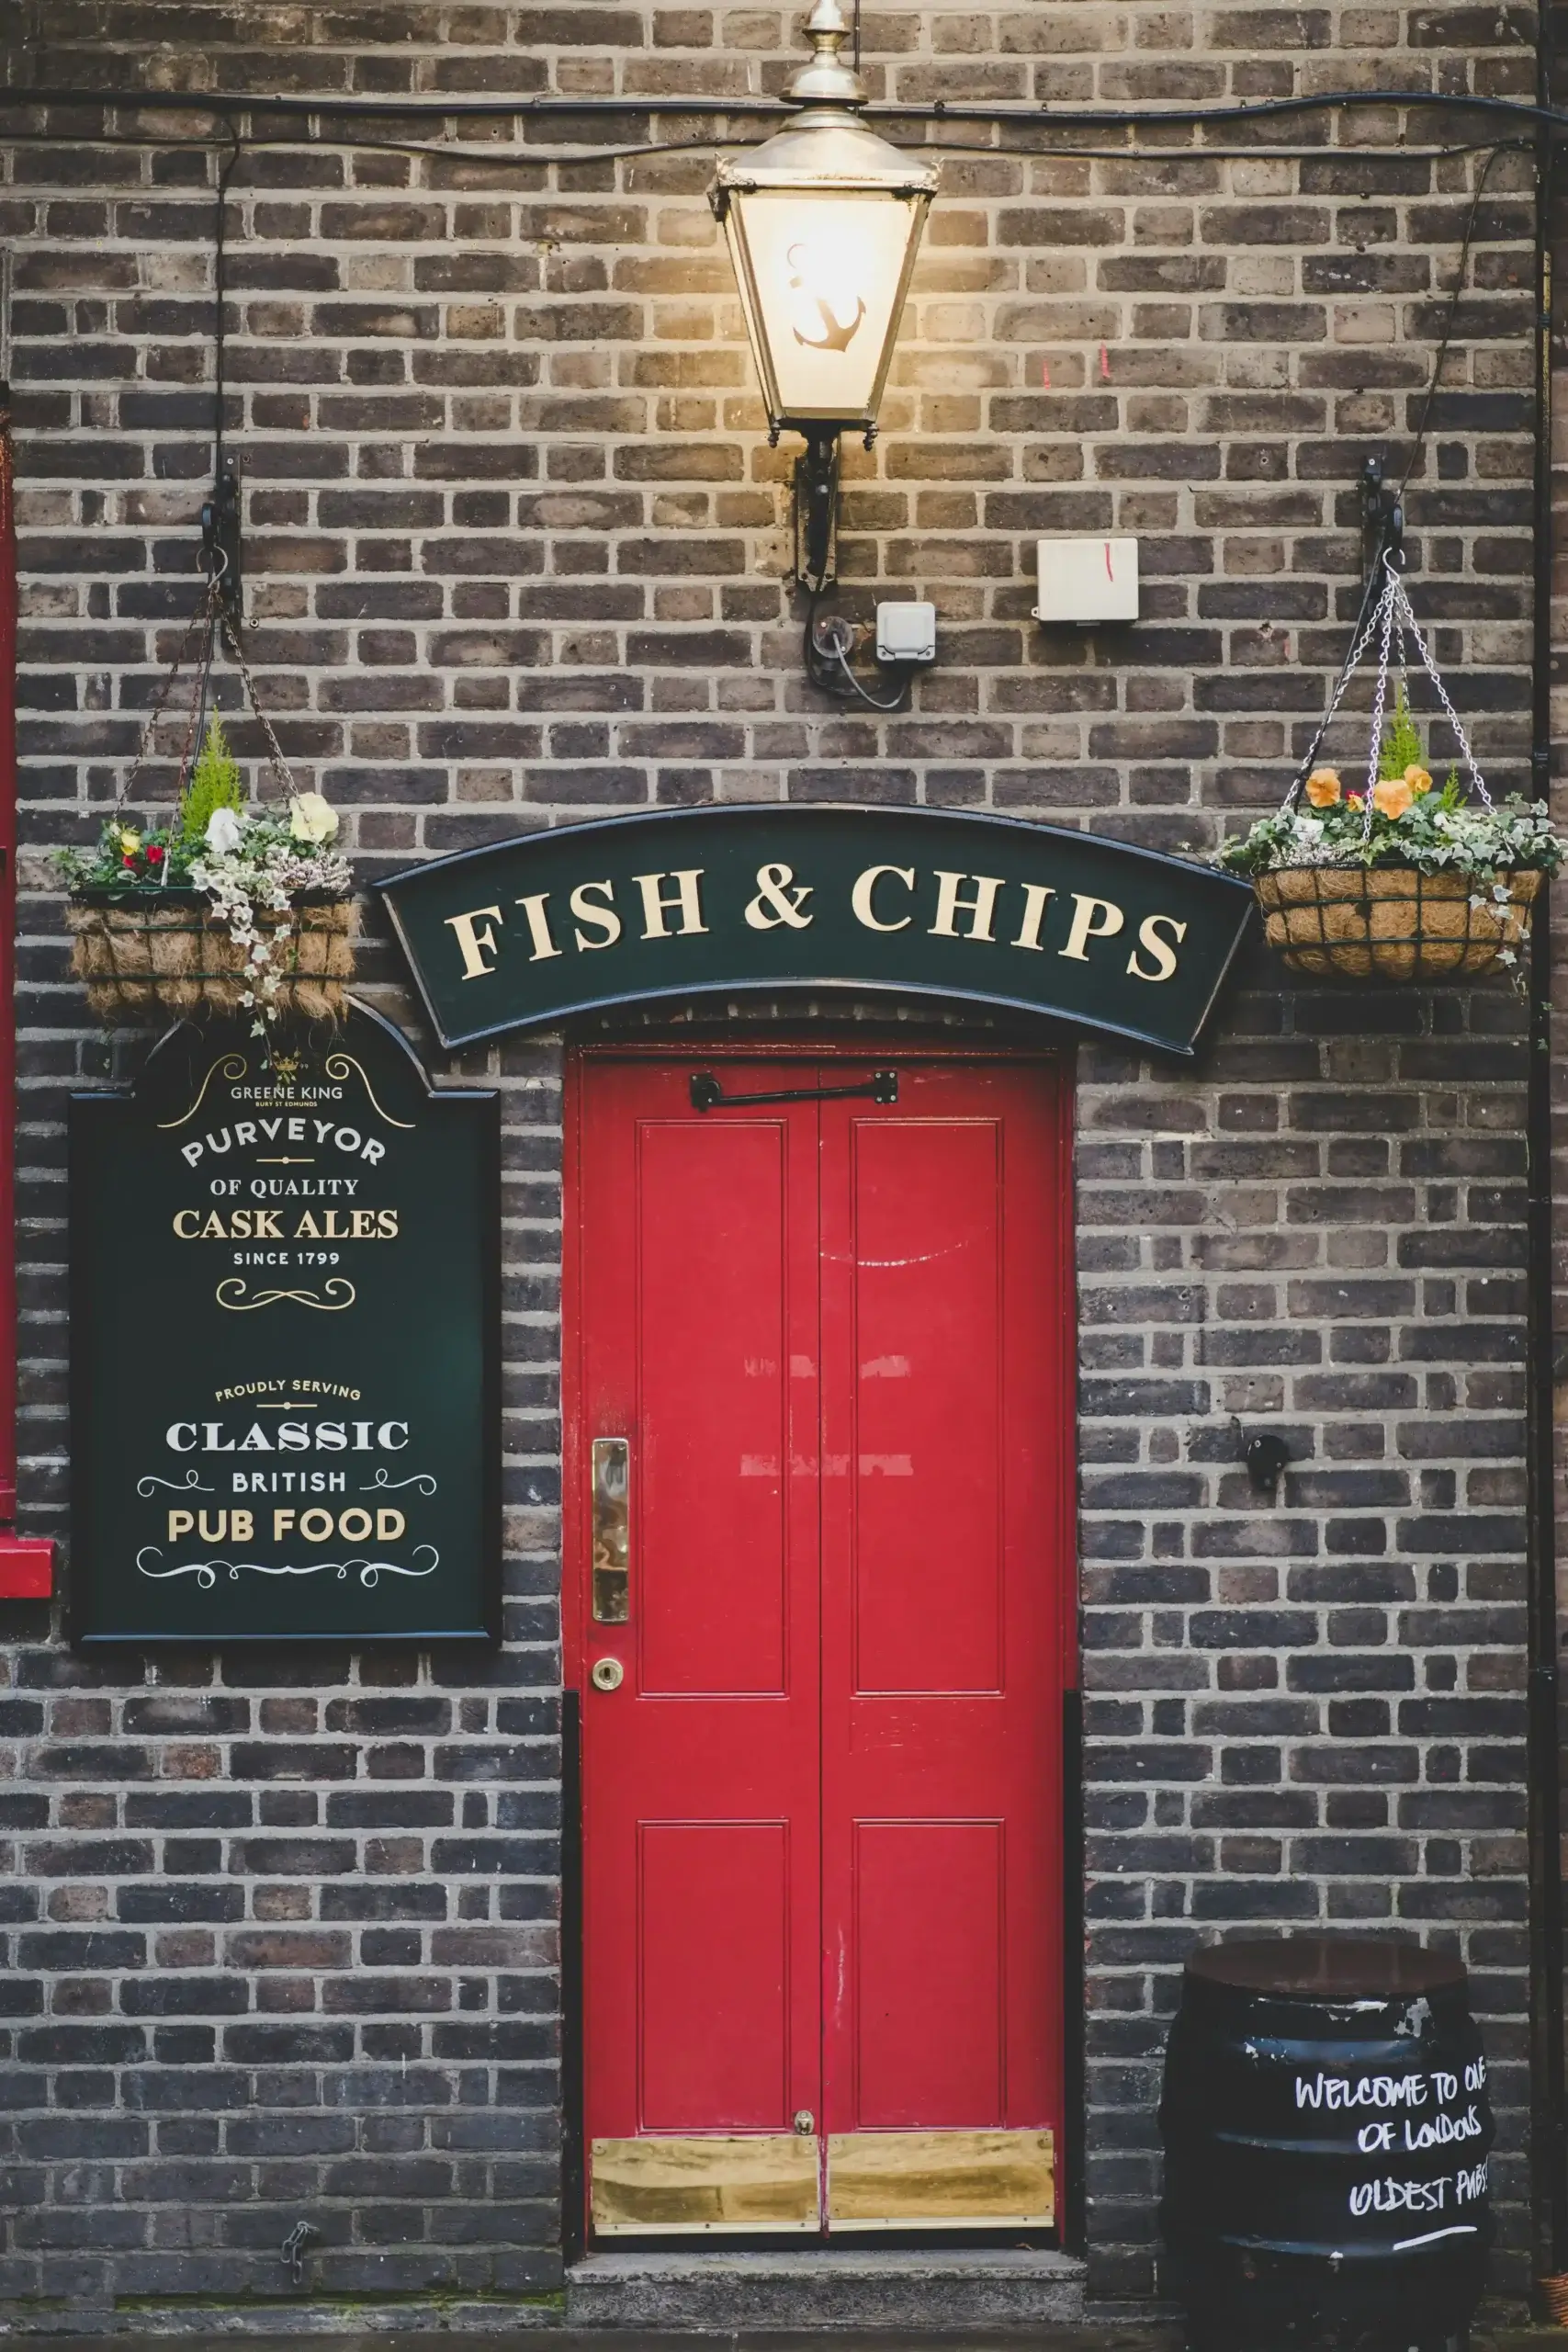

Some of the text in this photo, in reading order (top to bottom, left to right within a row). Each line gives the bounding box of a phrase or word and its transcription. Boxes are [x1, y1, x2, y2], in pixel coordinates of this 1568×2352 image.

[444, 863, 1190, 981] FISH & CHIPS
[230, 1086, 343, 1100] GREENE KING
[181, 1117, 386, 1168] PURVEYOR
[209, 1179, 359, 1198] OF QUALITY
[173, 1209, 399, 1239] CASK ALES
[233, 1251, 340, 1265] SINCE 1799
[214, 1379, 361, 1402] PROUDLY SERVING
[165, 1420, 410, 1452] CLASSIC
[232, 1471, 345, 1493] BRITISH
[168, 1507, 406, 1543] PUB FOOD
[1296, 2055, 1487, 2109] WELCOME TO ONE
[1358, 2121, 1396, 2153] OF
[1349, 2177, 1453, 2216] OLDEST
